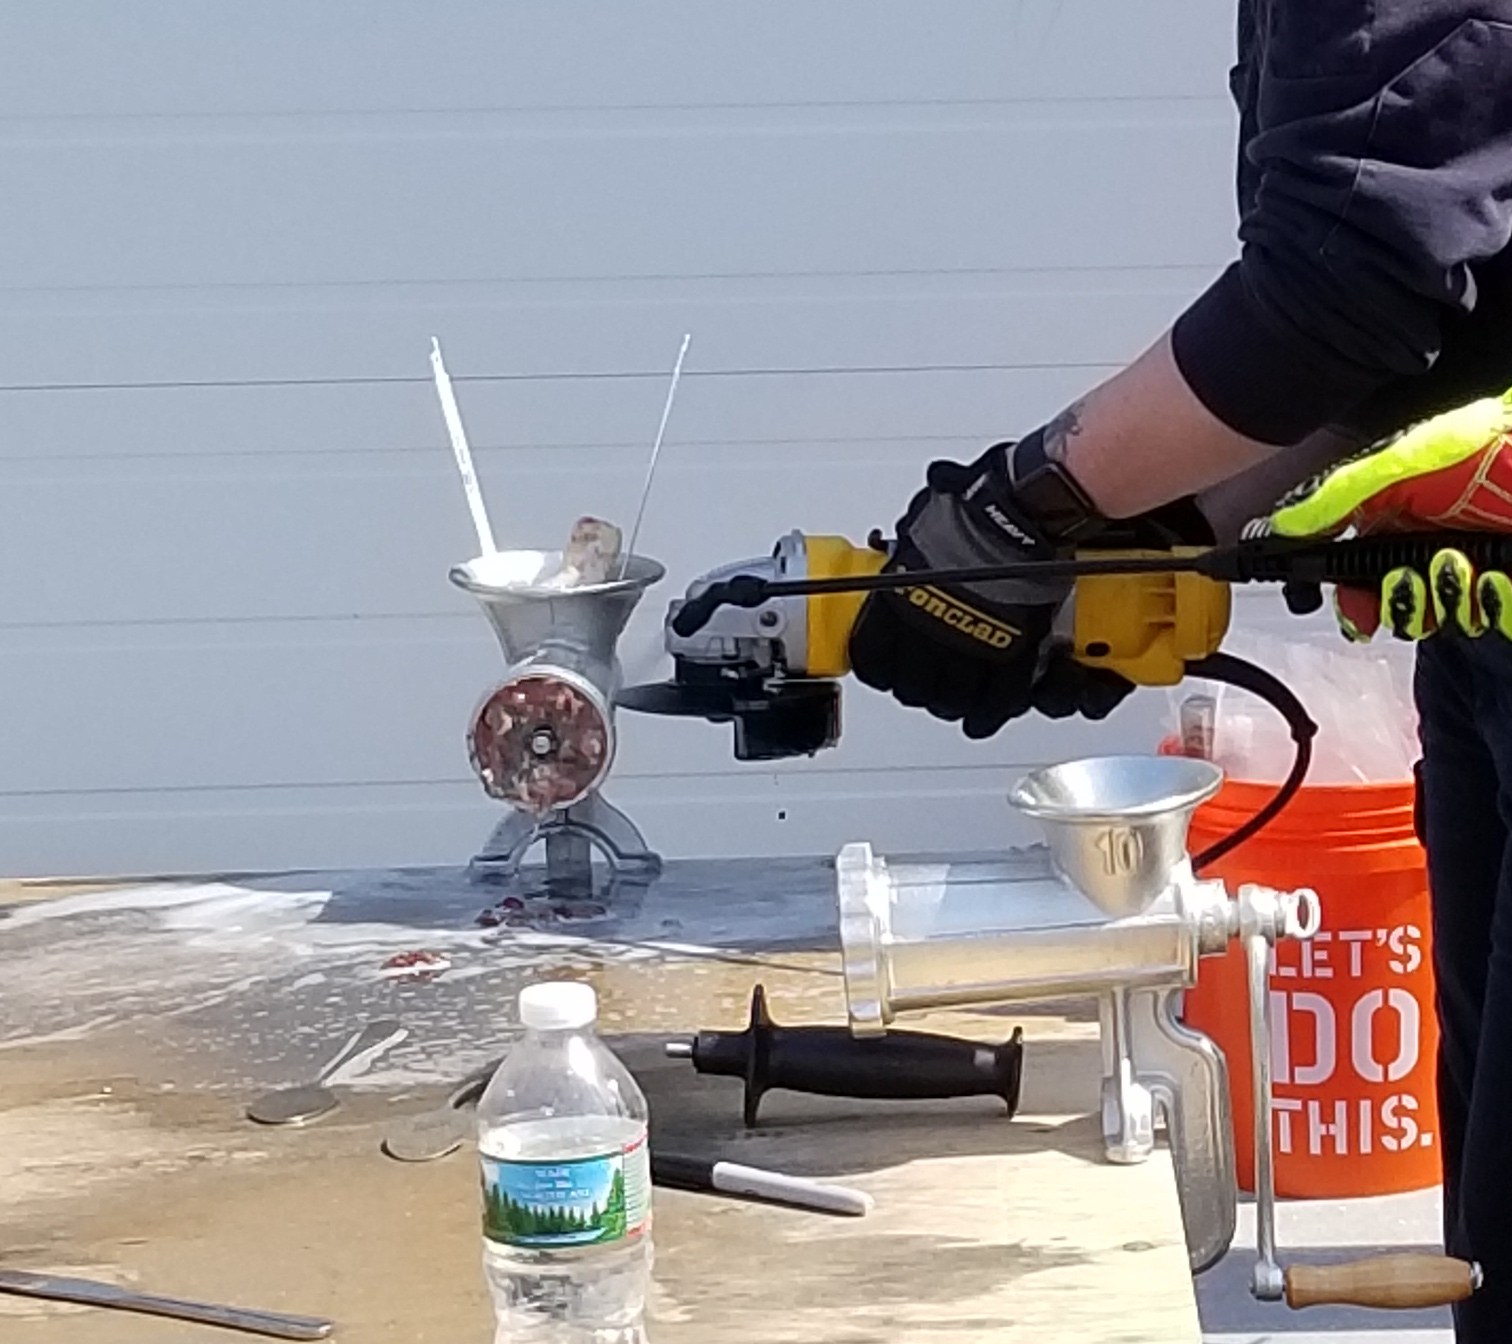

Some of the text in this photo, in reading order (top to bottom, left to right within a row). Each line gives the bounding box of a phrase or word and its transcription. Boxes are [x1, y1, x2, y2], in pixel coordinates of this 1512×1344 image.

[984, 504, 1036, 546] HEAVY
[1269, 924, 1422, 978] LET'S
[1268, 988, 1421, 1085] DO
[1270, 1093, 1434, 1156] THIS.
